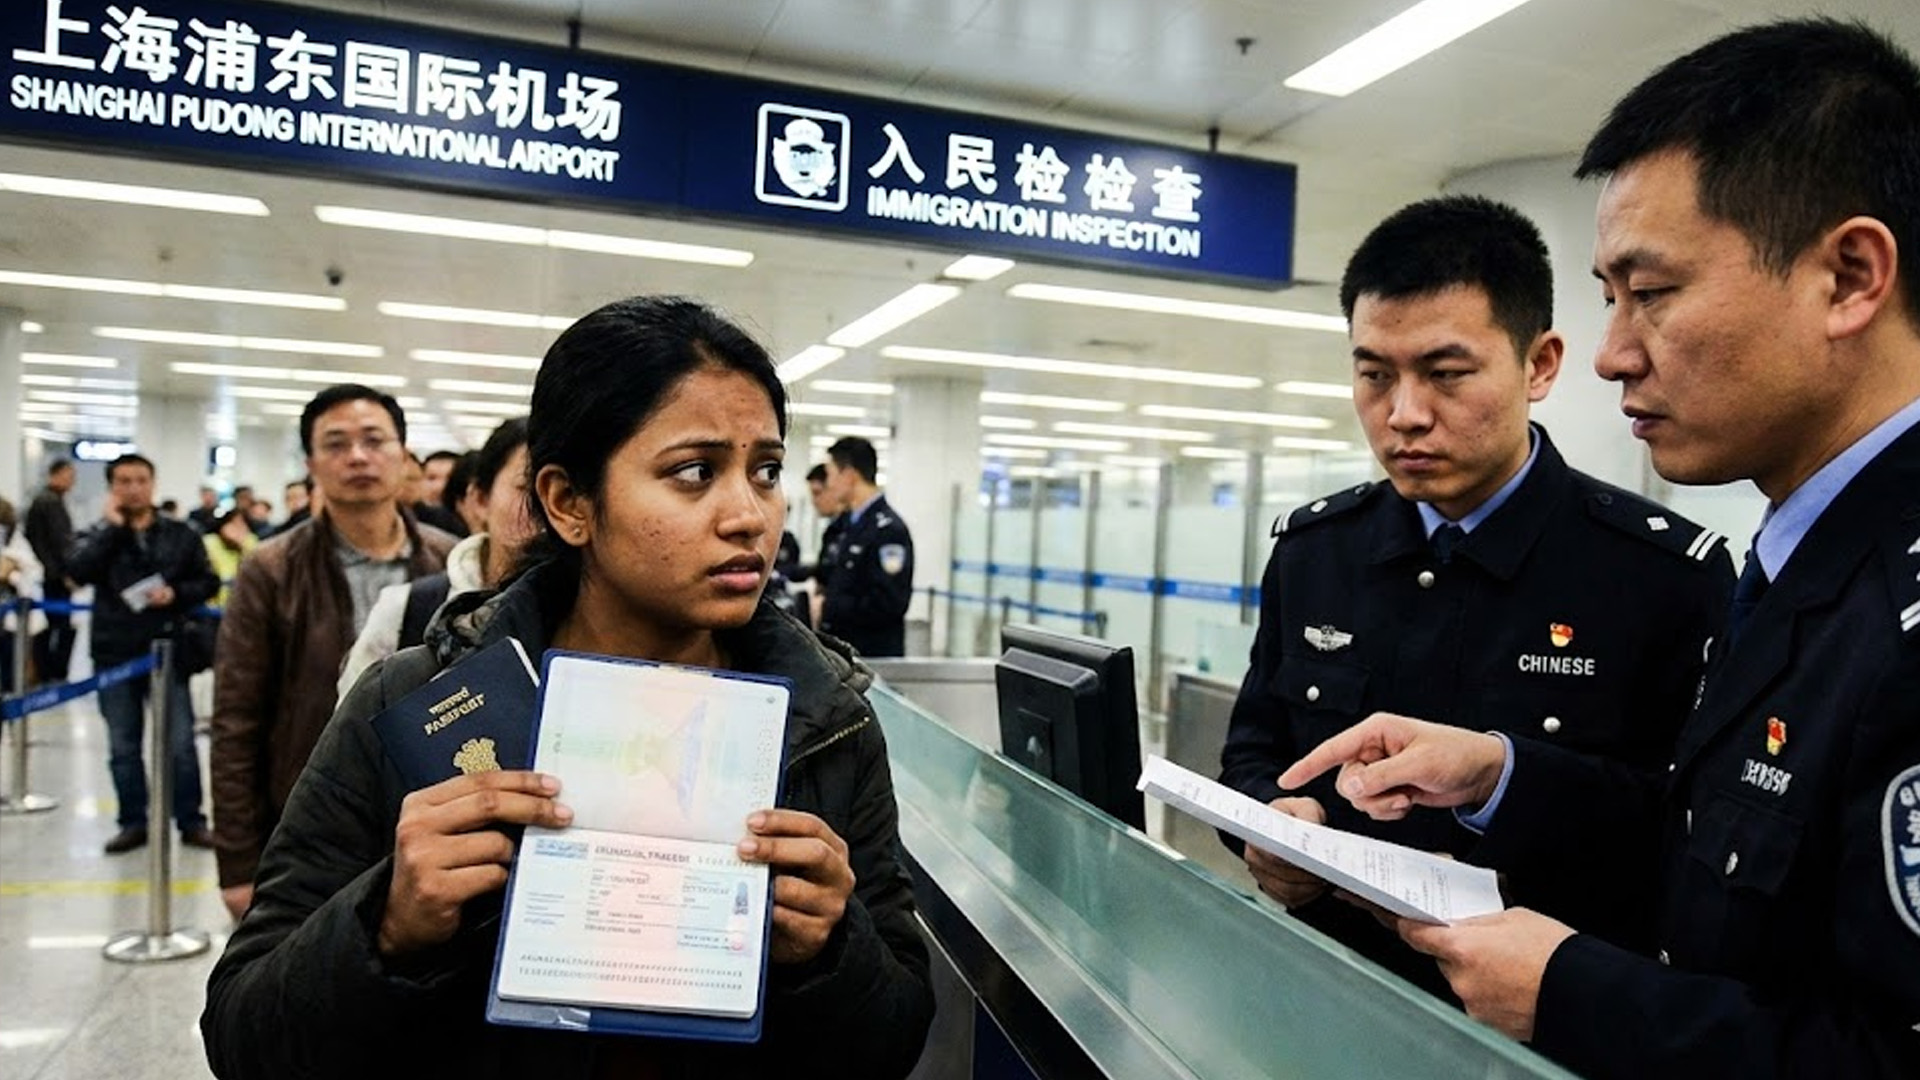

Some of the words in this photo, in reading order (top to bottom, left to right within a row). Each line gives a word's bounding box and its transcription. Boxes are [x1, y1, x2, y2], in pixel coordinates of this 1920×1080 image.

[12, 0, 622, 142] 上海浦东国际机场
[10, 74, 166, 126] SHANGHAI
[171, 95, 295, 142] PUDONG
[299, 111, 506, 169] INTERNATIONAL
[508, 138, 620, 182] AIRPORT
[867, 185, 1048, 238] IMMIGRATION
[1051, 211, 1202, 258] INSPECTION
[1518, 654, 1596, 676] CHINESE
